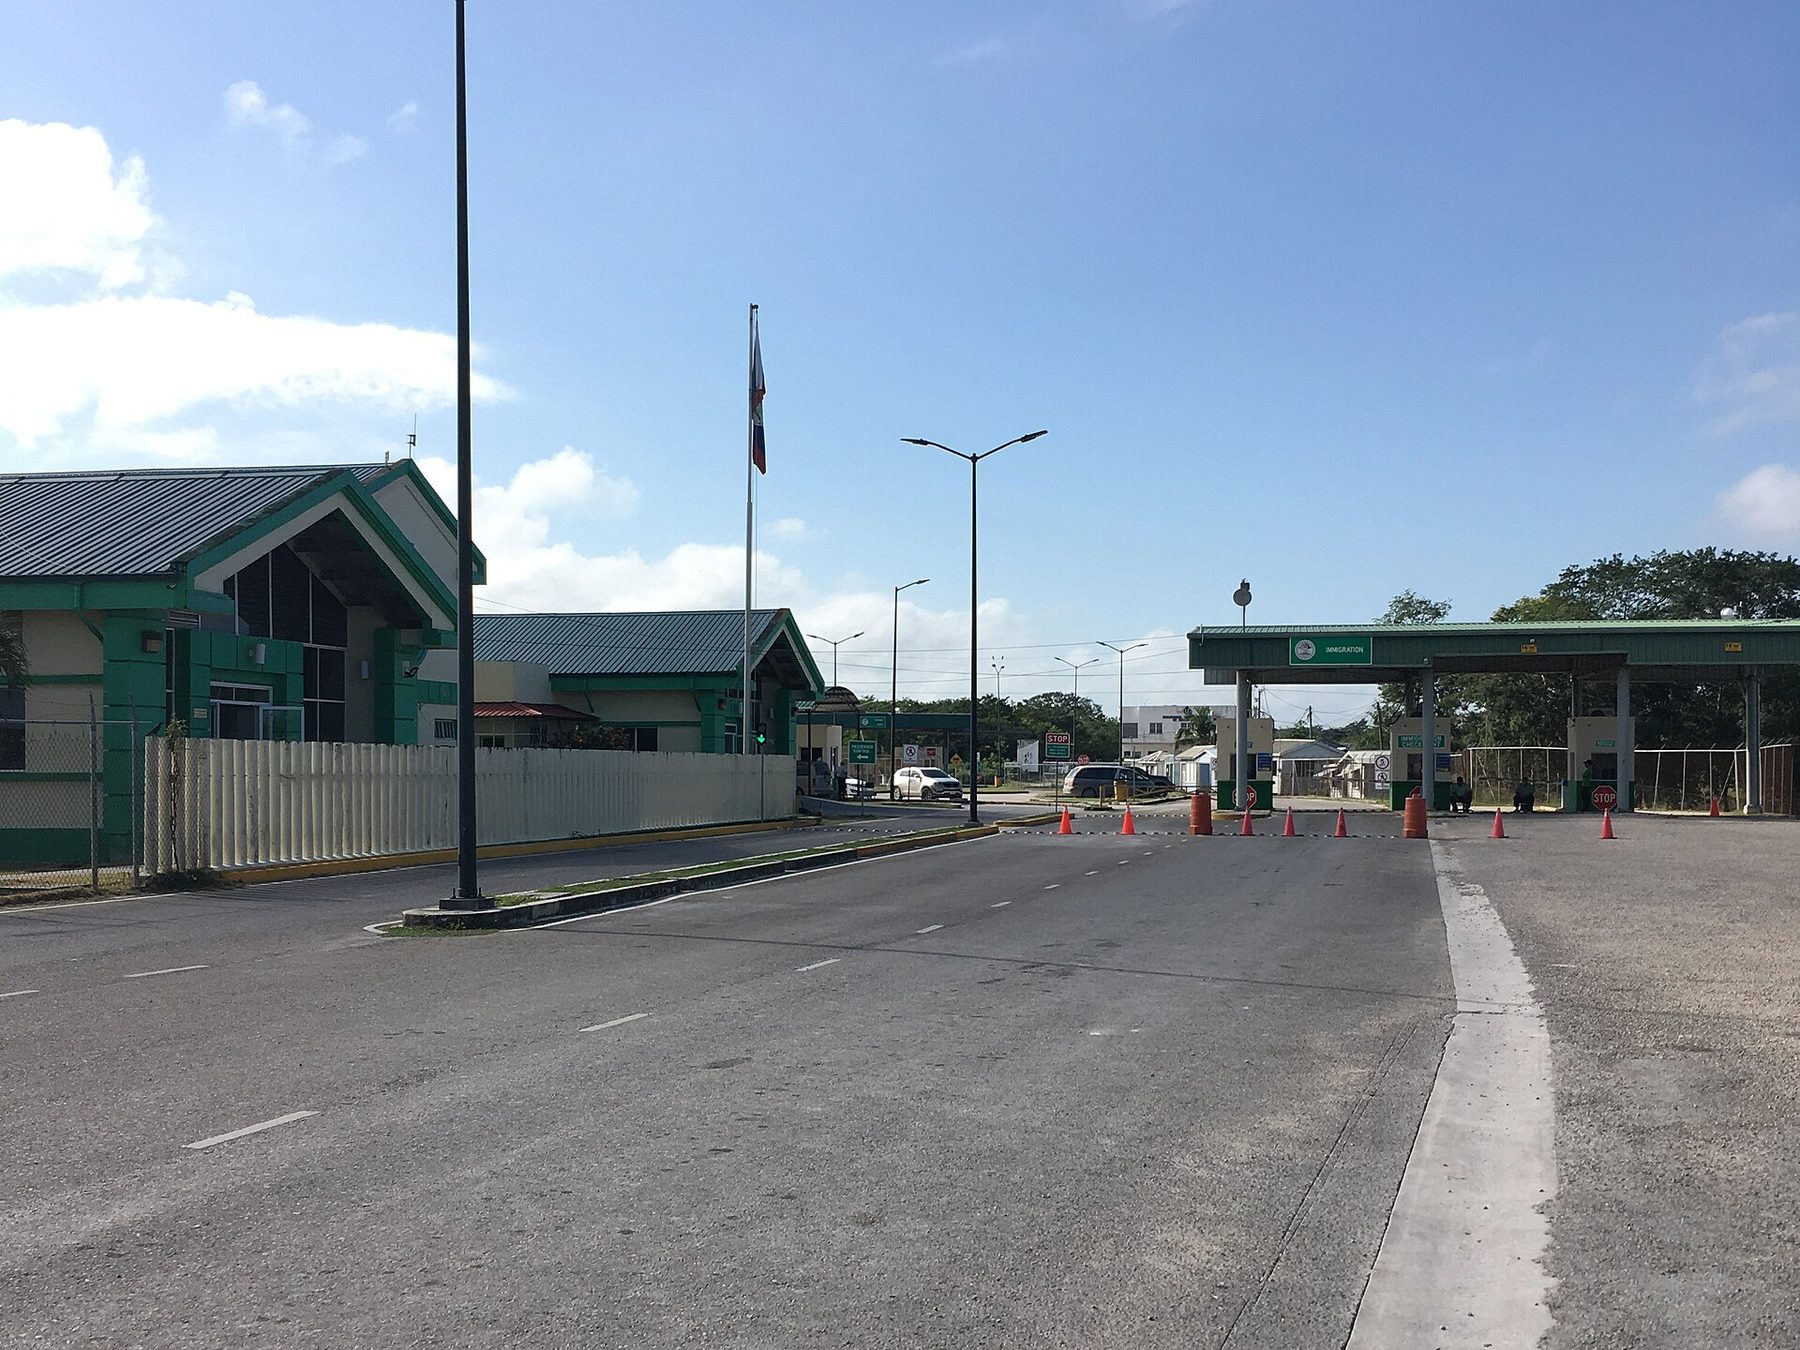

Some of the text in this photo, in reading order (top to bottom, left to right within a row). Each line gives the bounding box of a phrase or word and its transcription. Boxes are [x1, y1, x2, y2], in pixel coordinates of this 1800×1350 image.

[1326, 646, 1364, 654] IMMIGRATION
[1047, 735, 1068, 743] STOP
[1593, 793, 1616, 803] STOP
